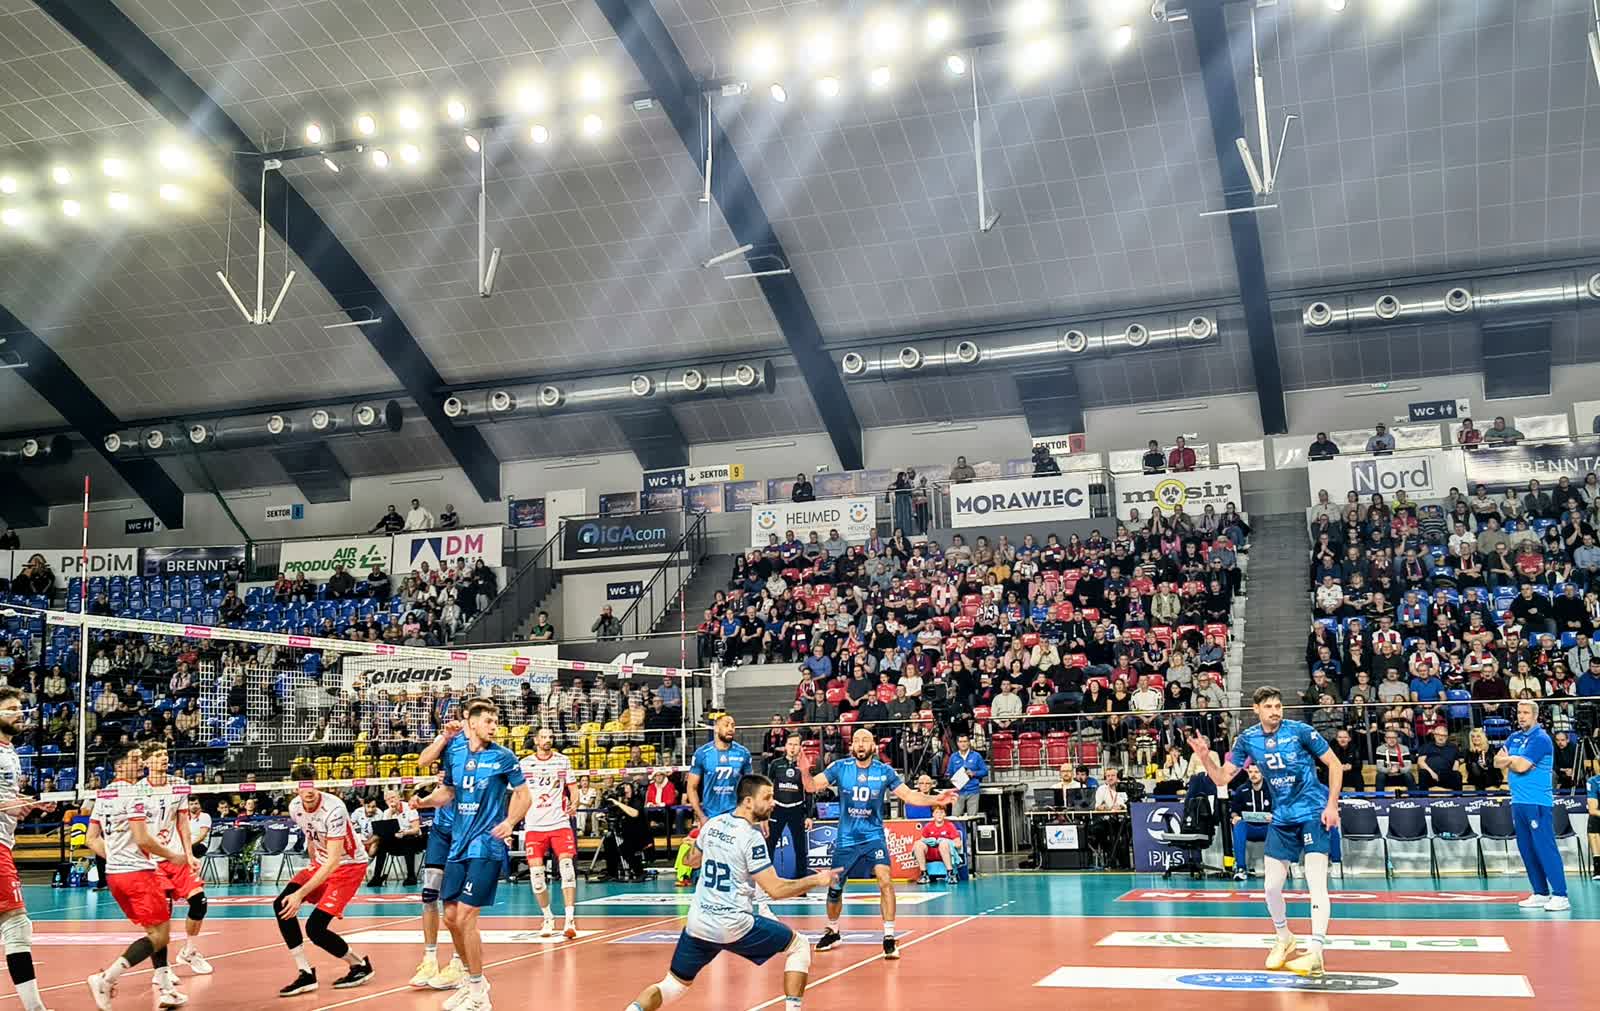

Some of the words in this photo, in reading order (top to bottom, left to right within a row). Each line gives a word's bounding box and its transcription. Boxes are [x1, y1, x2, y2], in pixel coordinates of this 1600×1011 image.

[1413, 407, 1436, 416] WC
[699, 469, 729, 480] SEKTOR
[734, 466, 740, 478] 9
[1354, 460, 1430, 492] Nord
[648, 476, 669, 487] WC
[956, 488, 1084, 514] MORAWIEC
[266, 508, 291, 519] SEKTOR
[786, 509, 841, 525] HELIMED
[127, 522, 142, 530] WC
[446, 533, 484, 556] DM
[333, 547, 358, 559] AIR
[284, 558, 357, 573] PRODUCTS
[609, 587, 627, 596] WC
[1264, 752, 1287, 769] 21
[715, 766, 734, 780] 77
[462, 775, 475, 793] 4
[852, 786, 870, 802] 10
[808, 857, 833, 867] ZAK
[1148, 850, 1185, 867] PLS
[704, 858, 731, 892] 92
